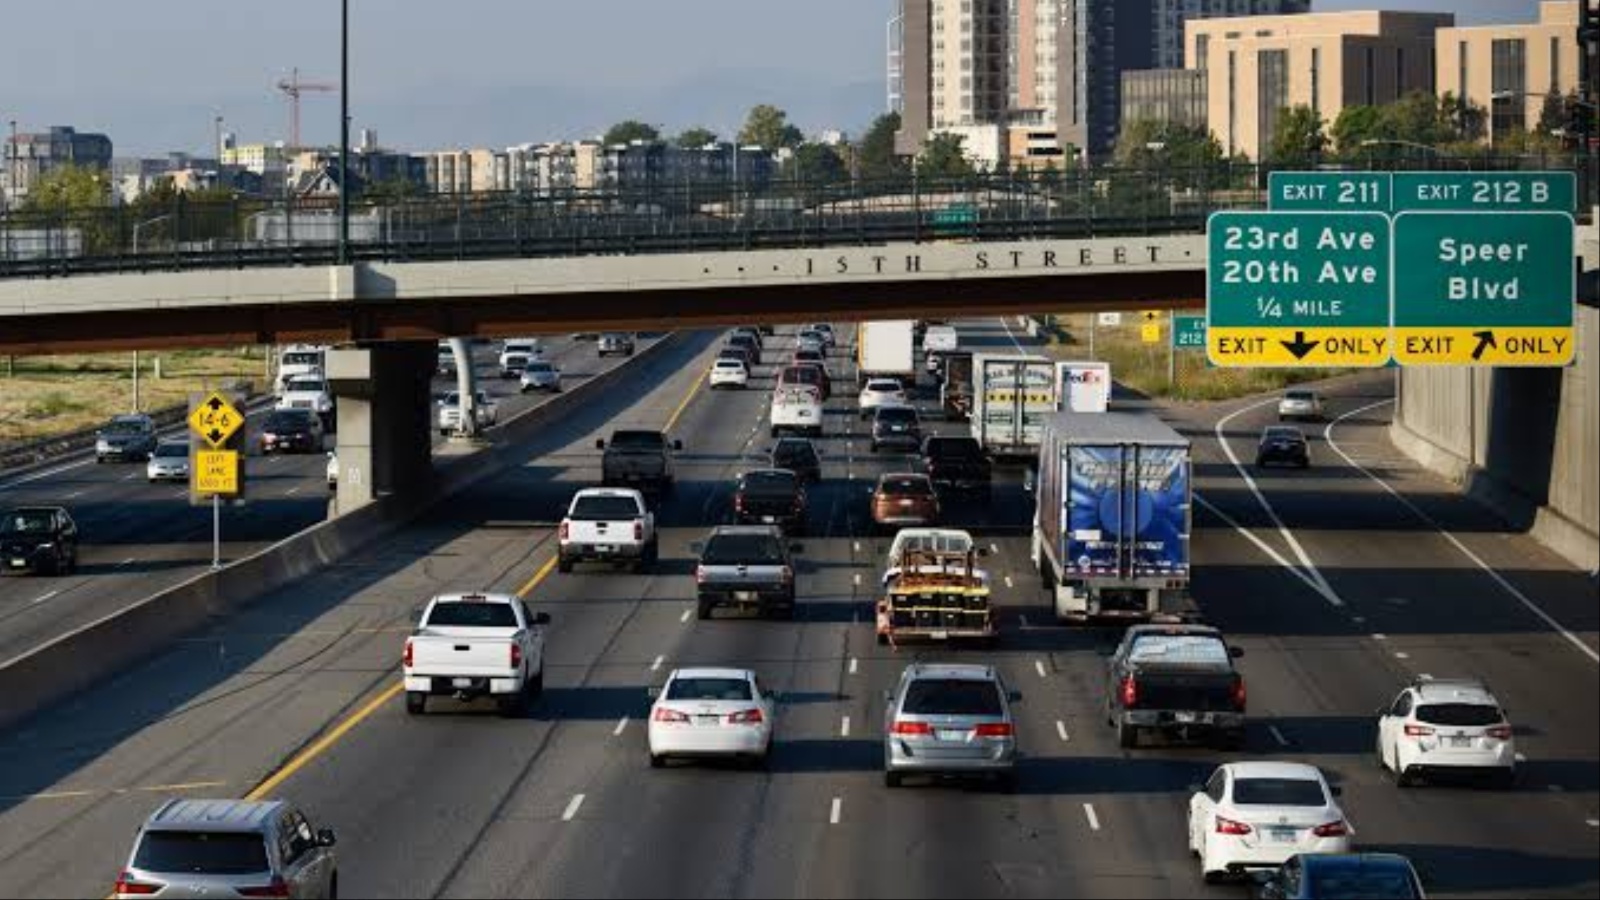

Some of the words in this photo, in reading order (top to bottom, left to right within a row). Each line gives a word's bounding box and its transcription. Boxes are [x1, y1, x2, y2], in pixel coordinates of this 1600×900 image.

[1282, 184, 1327, 200] EXIT
[1337, 182, 1379, 203] 211
[1417, 184, 1461, 200] EXIT
[1472, 181, 1521, 203] 212
[1531, 181, 1549, 203] B
[1224, 227, 1299, 250] 23rd
[1316, 227, 1375, 250] Ave
[806, 255, 921, 275] 15TH
[976, 245, 1162, 269] STREET
[1438, 238, 1528, 266] Speer
[1222, 260, 1299, 283] 20th
[1318, 260, 1377, 283] Ave
[1449, 277, 1519, 300] Blvd
[1293, 300, 1342, 316] MILE
[1179, 332, 1202, 344] 212
[1218, 337, 1267, 354] EXIT
[1325, 337, 1387, 354] ONLY
[1406, 336, 1455, 354] EXIT
[1505, 336, 1567, 354] ONLY
